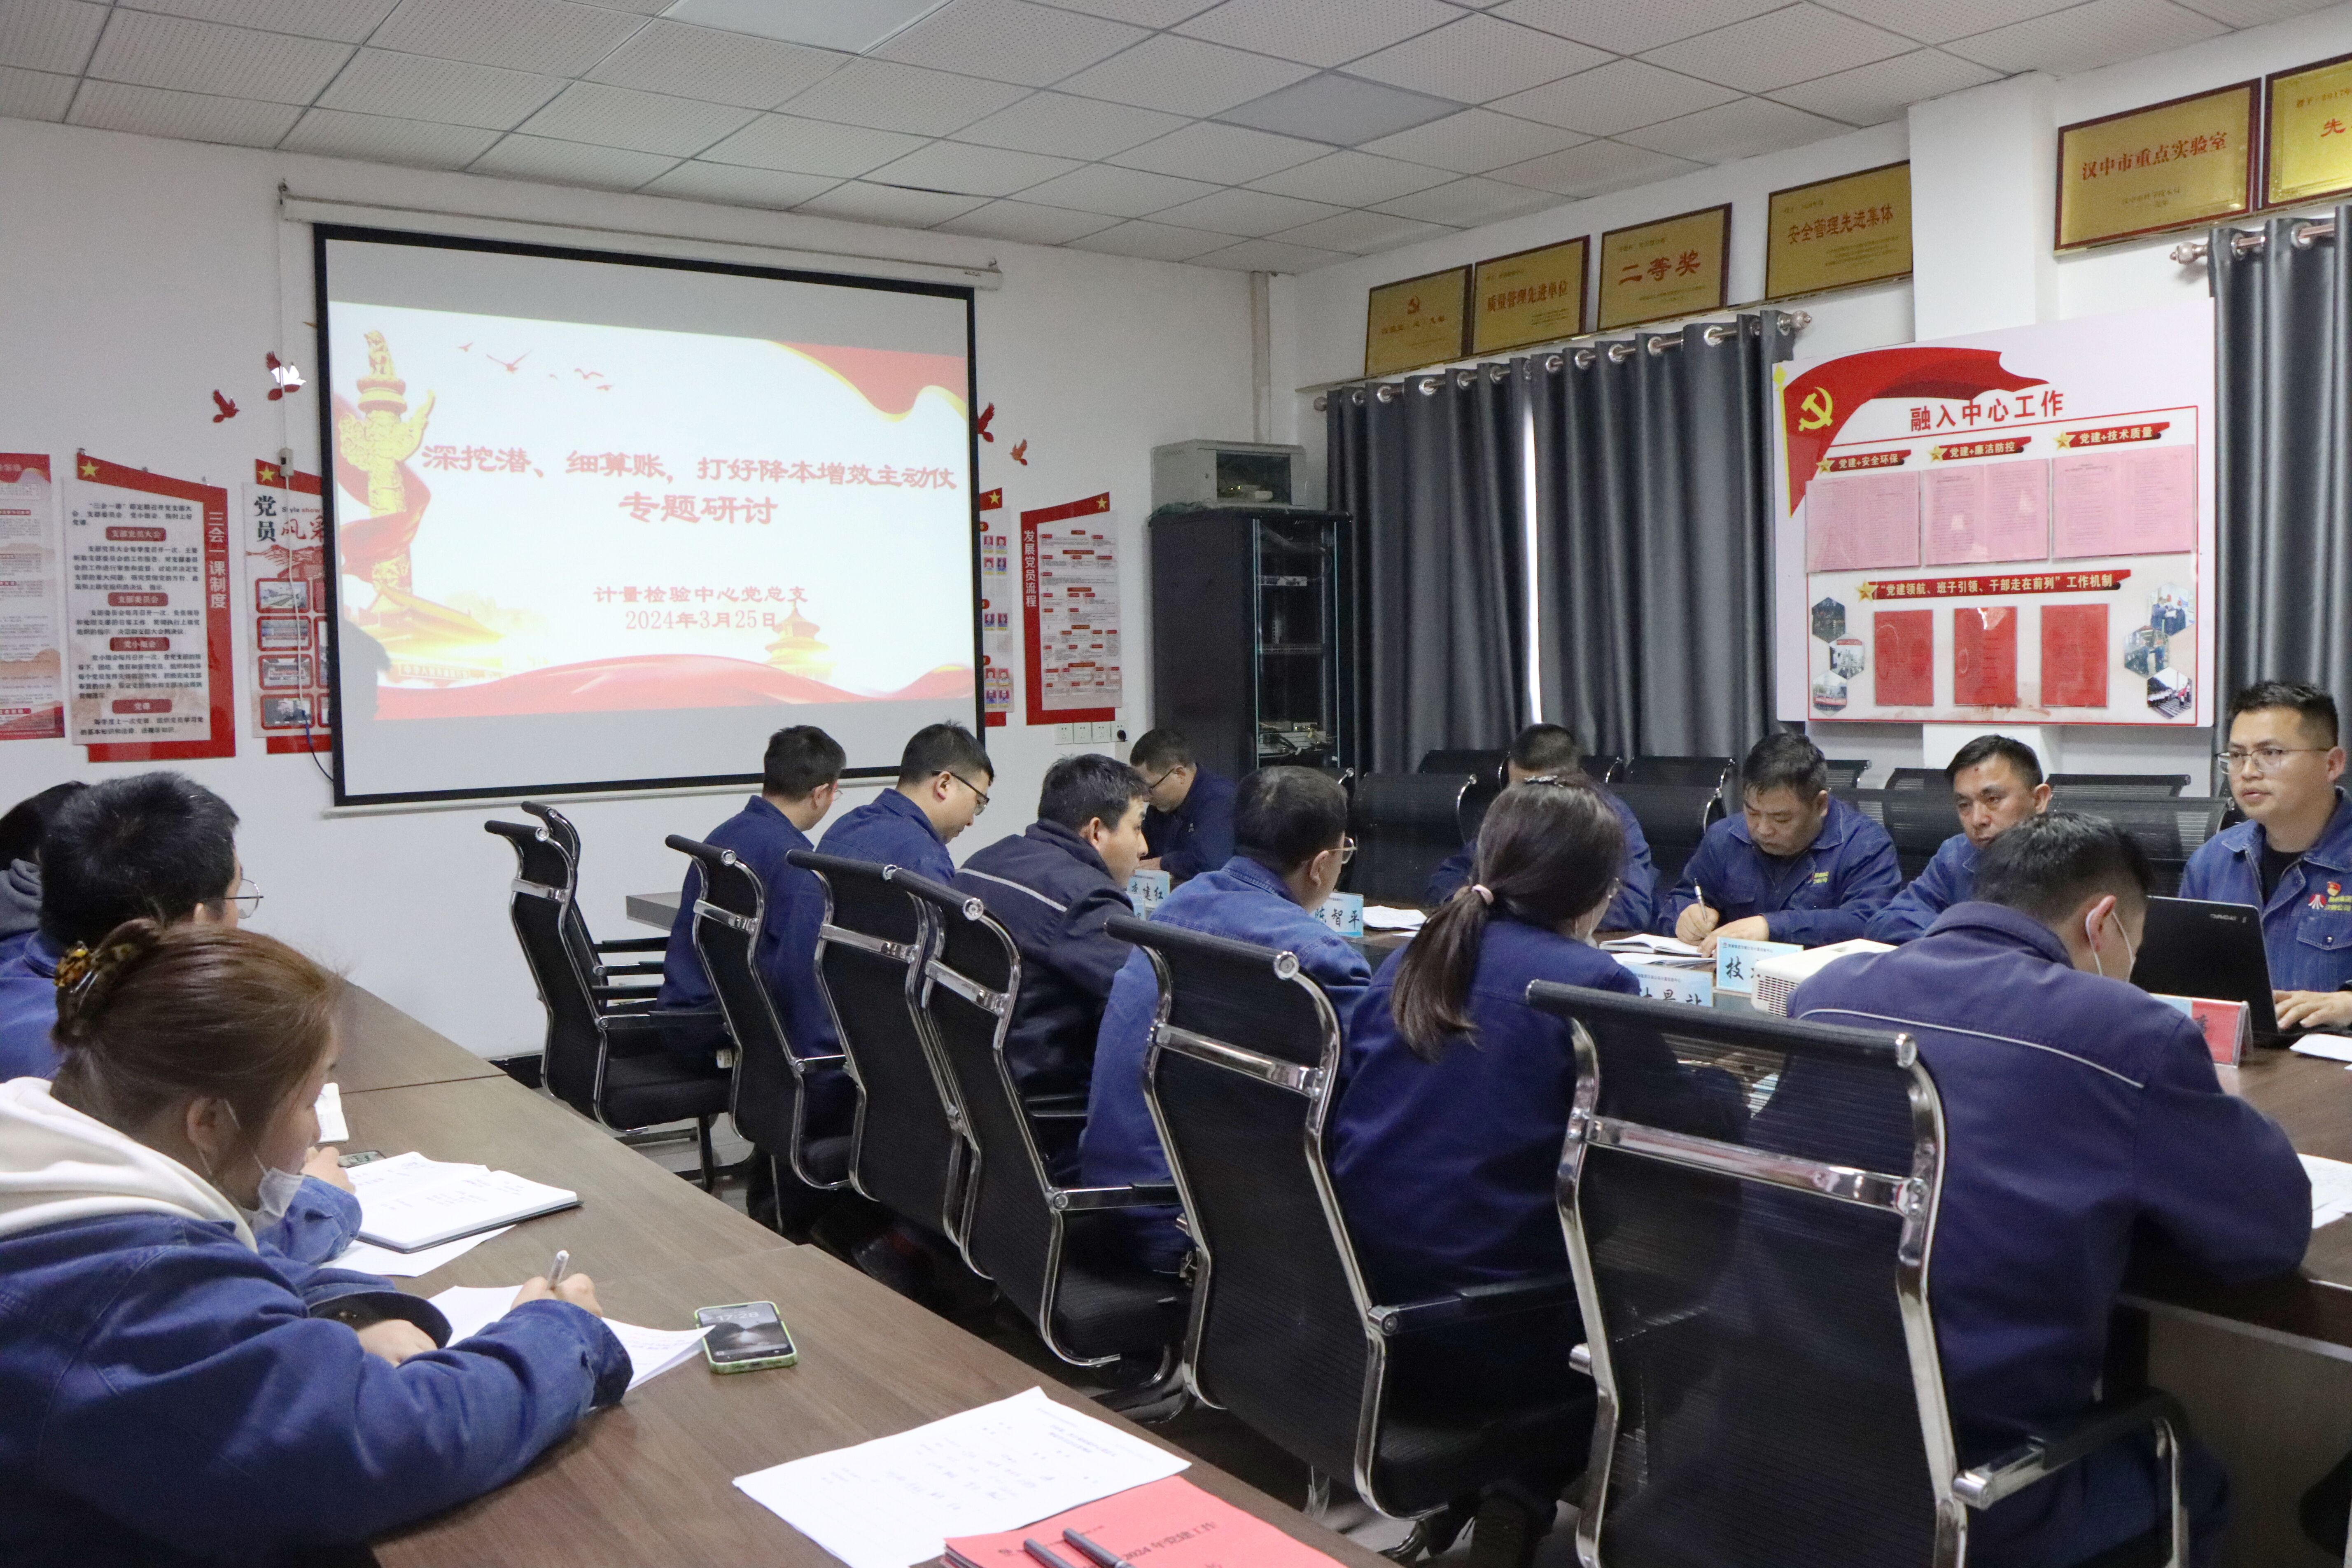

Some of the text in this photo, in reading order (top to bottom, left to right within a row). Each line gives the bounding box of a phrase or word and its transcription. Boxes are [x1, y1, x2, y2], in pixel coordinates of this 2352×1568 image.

[2083, 131, 2227, 180] 汉中市重点实验室
[1788, 204, 1894, 245] 安全管理先进集体
[1618, 250, 1701, 286] 二等奖
[1488, 280, 1568, 312] 质量管理先进单位
[1910, 390, 2064, 432] 融入中心工作
[1950, 441, 2015, 457] 党建+廉洁防控
[2080, 427, 2153, 444] 党建+技术质量
[1839, 454, 1898, 469] 党建+安全环保
[254, 495, 276, 542] 党员
[618, 491, 778, 524] 专题研讨
[209, 512, 226, 609] 三会一课制度
[1024, 530, 1037, 607] 发展党员流程
[593, 586, 808, 603] 计量检验中心党总支
[625, 610, 776, 630] 2024年3月25日
[716, 1311, 760, 1321] 17:28
